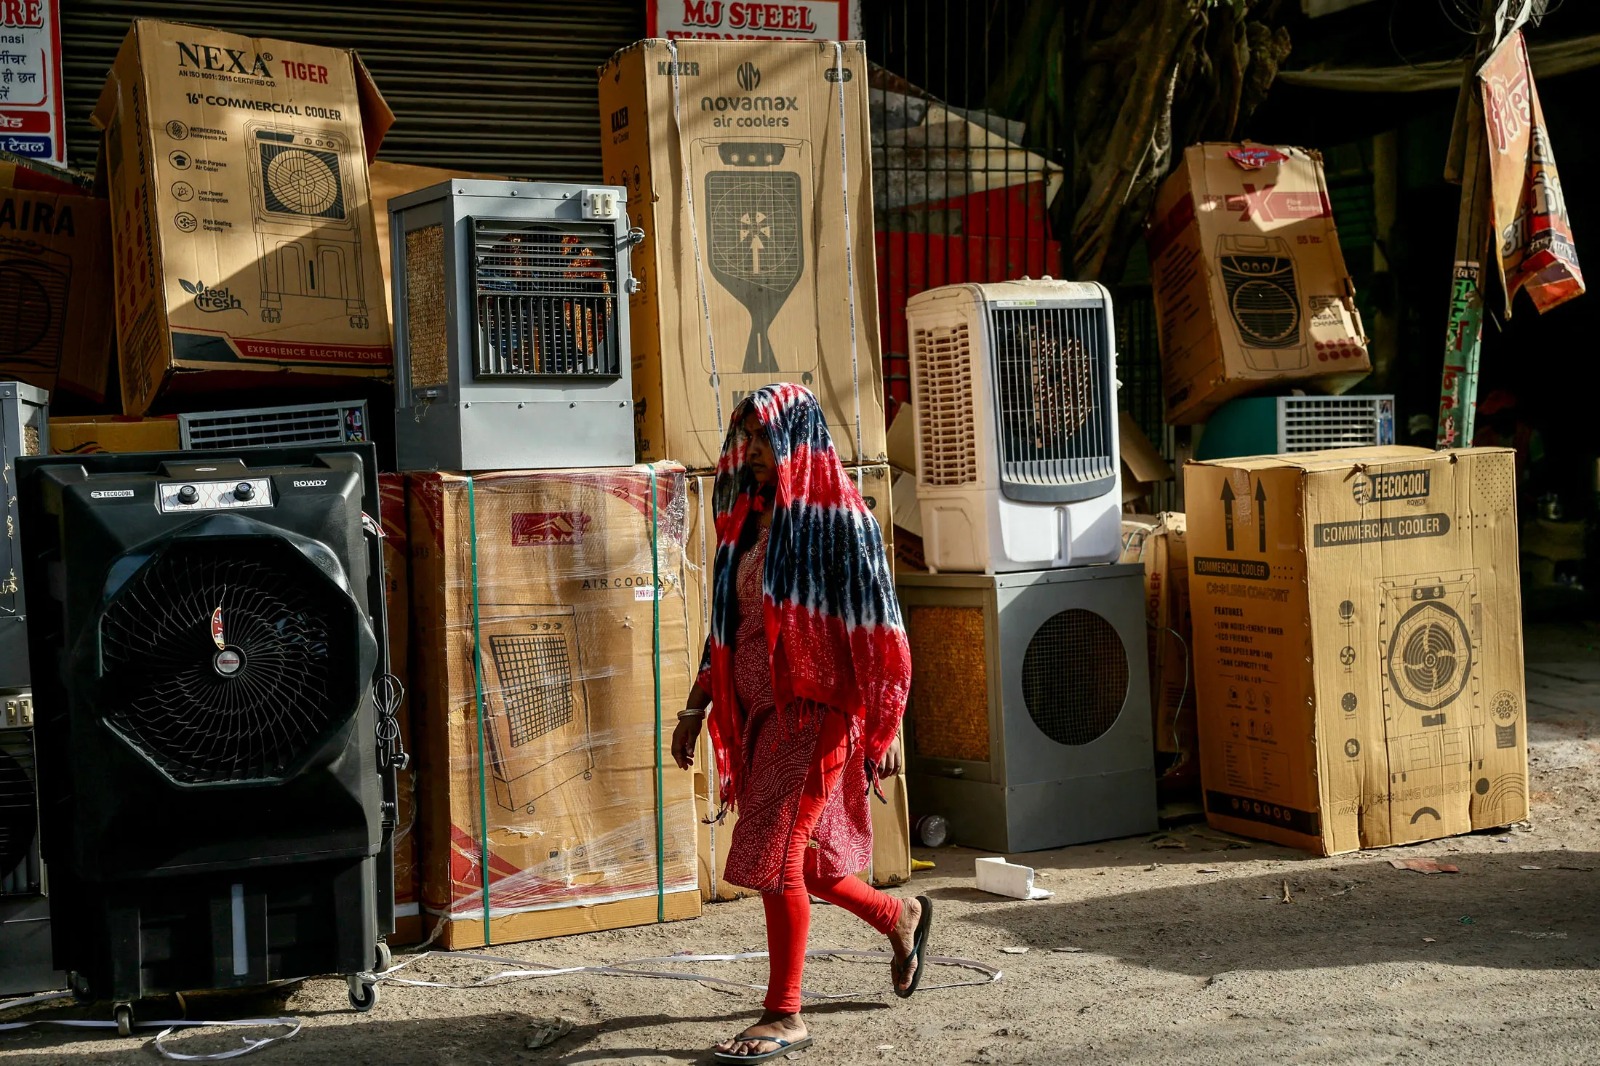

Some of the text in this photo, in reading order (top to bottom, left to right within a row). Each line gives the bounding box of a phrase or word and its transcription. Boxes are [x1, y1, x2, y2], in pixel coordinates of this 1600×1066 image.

[682, 0, 815, 32] MJ STEEL
[2, 71, 36, 84] ही छत
[281, 59, 329, 85] TIGER
[186, 92, 342, 121] 16" COMMERCIAL COOLER
[701, 96, 799, 112] novamax
[713, 115, 790, 128] air coolers
[197, 292, 242, 309] fresh
[203, 286, 229, 299] feel
[247, 345, 384, 360] EXPERIENCE ELECTRIC ZONE
[293, 479, 328, 487] ROWDY
[1375, 473, 1427, 499] EECOCOOL
[1323, 517, 1440, 543] COMMERCIAL COOLER
[1197, 560, 1265, 577] COMMERCIAL COOLER
[582, 577, 608, 589] AIR
[1214, 606, 1243, 617] FEATURES
